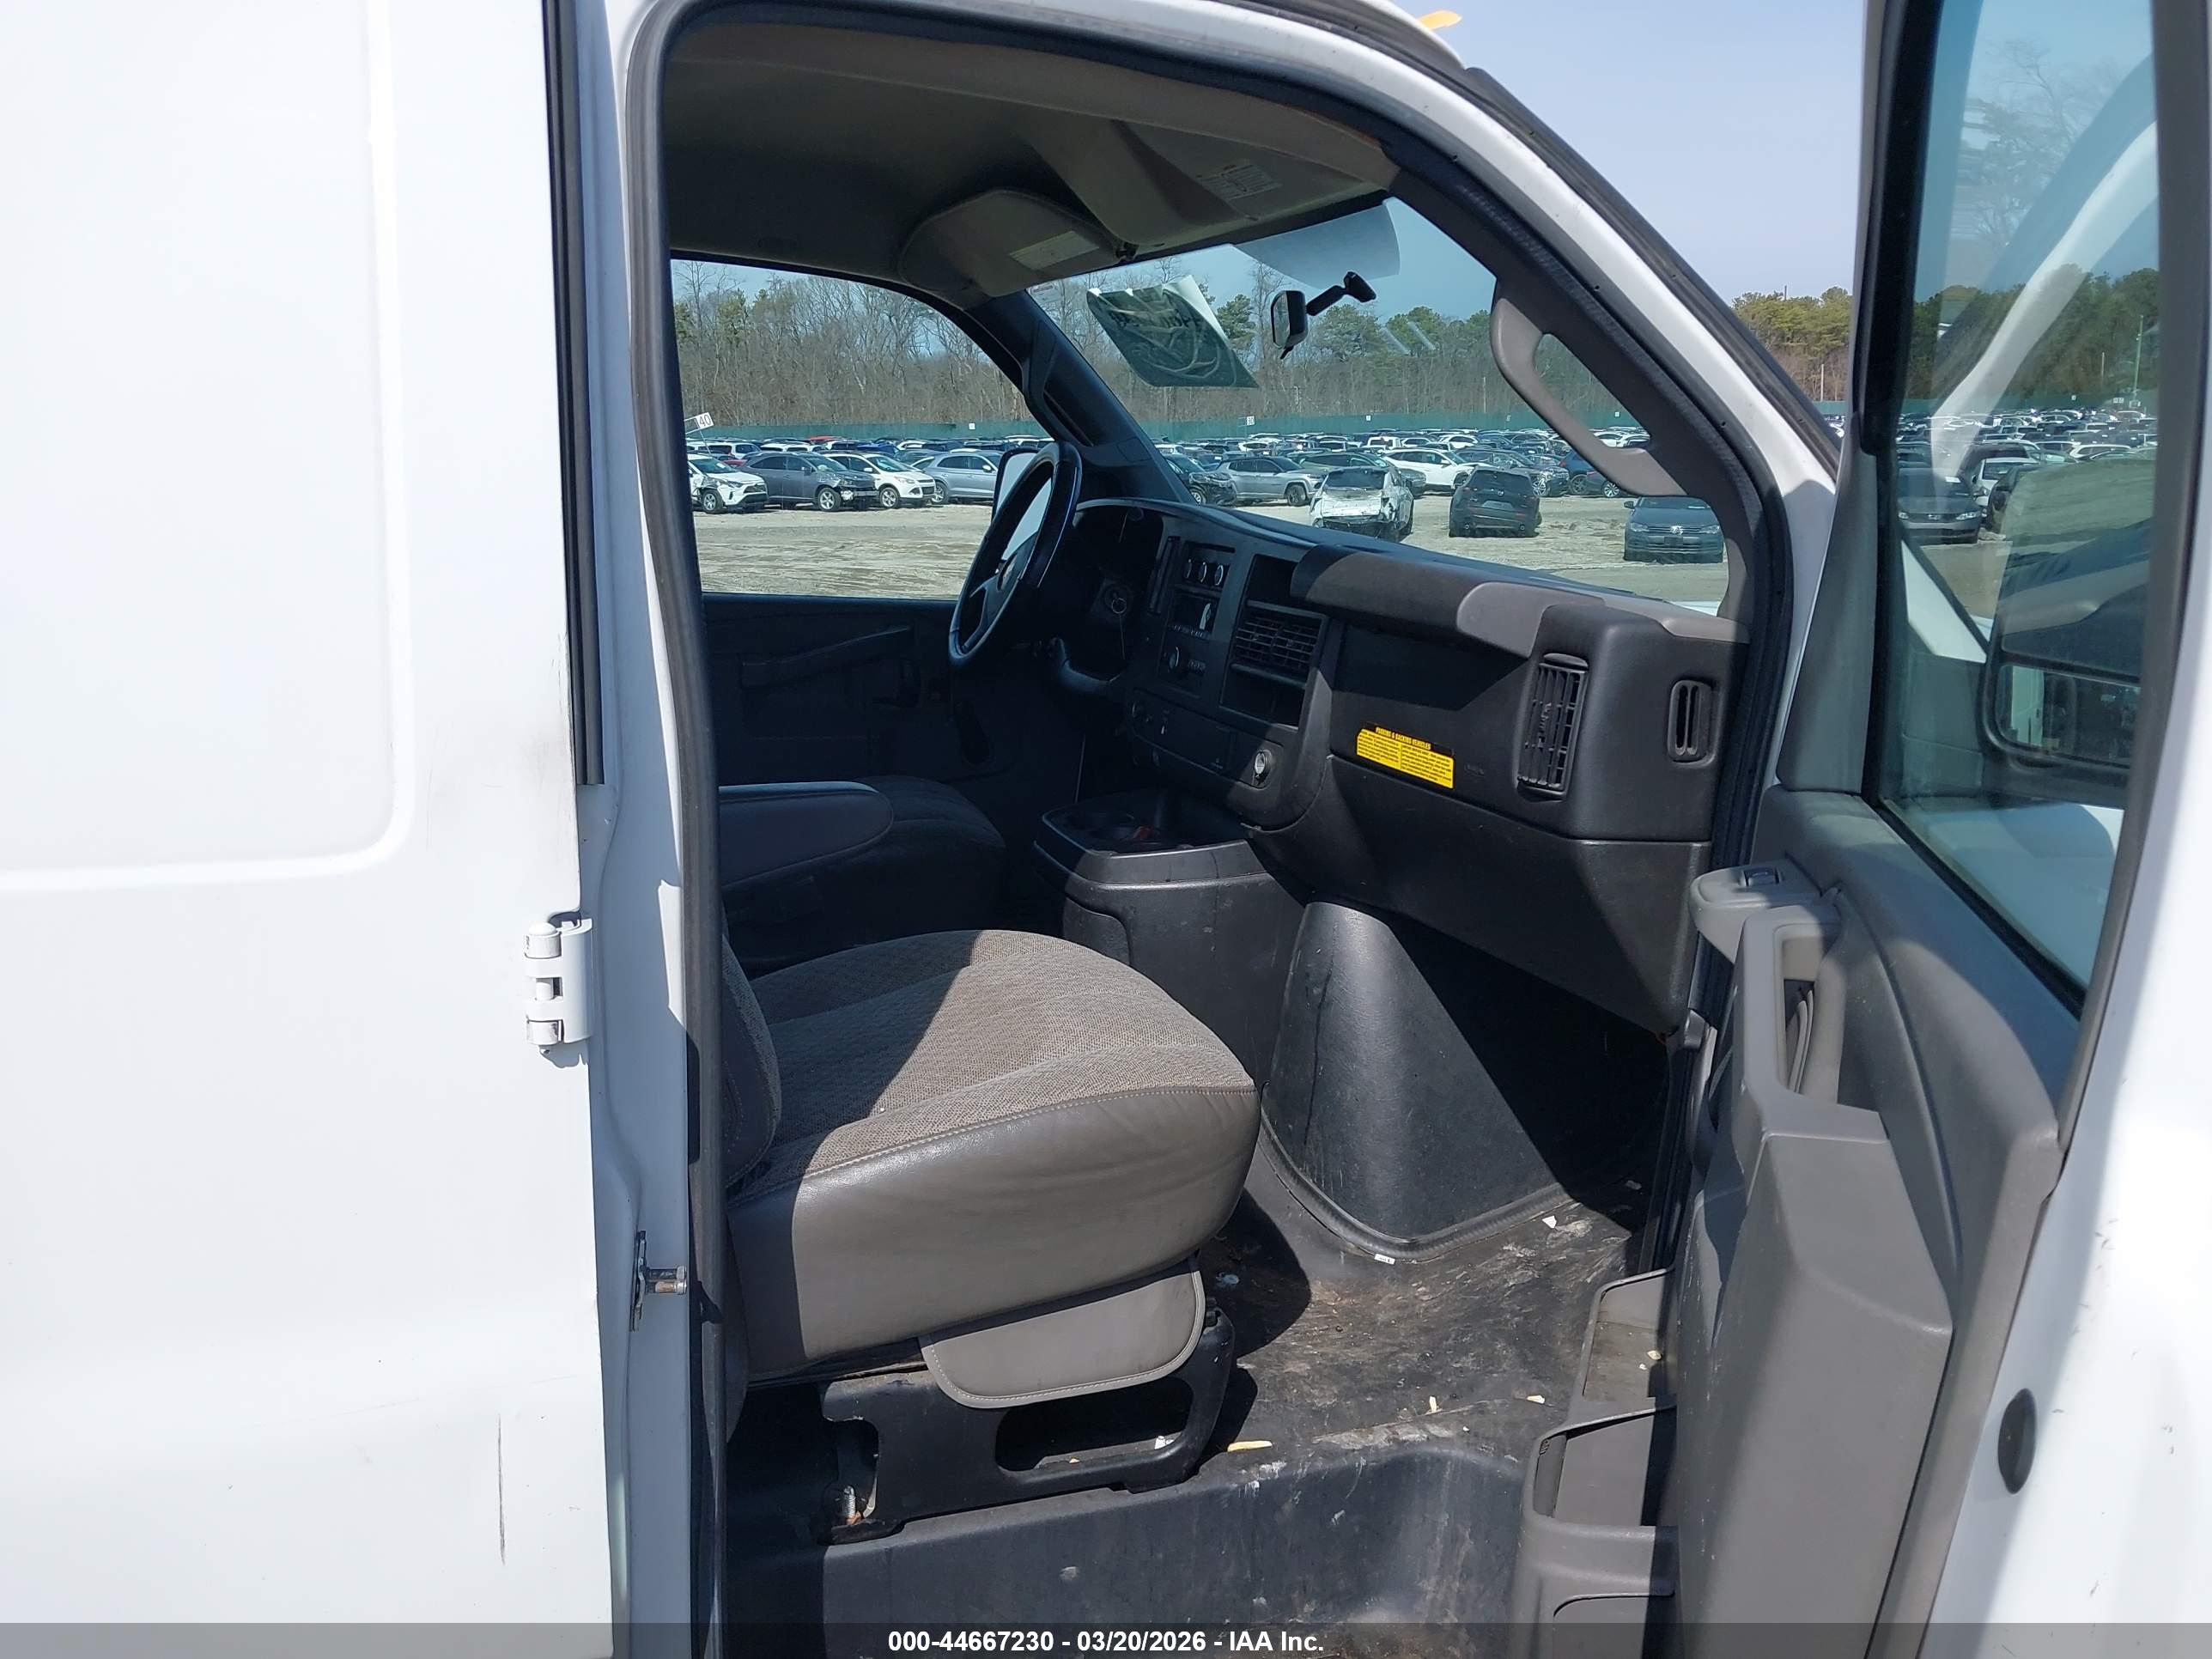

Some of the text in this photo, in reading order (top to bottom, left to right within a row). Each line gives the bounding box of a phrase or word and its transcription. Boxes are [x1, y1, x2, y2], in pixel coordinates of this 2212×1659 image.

[700, 414, 711, 427] 40
[1395, 733, 1413, 744] BACKING
[1413, 739, 1431, 750] VEHICLES
